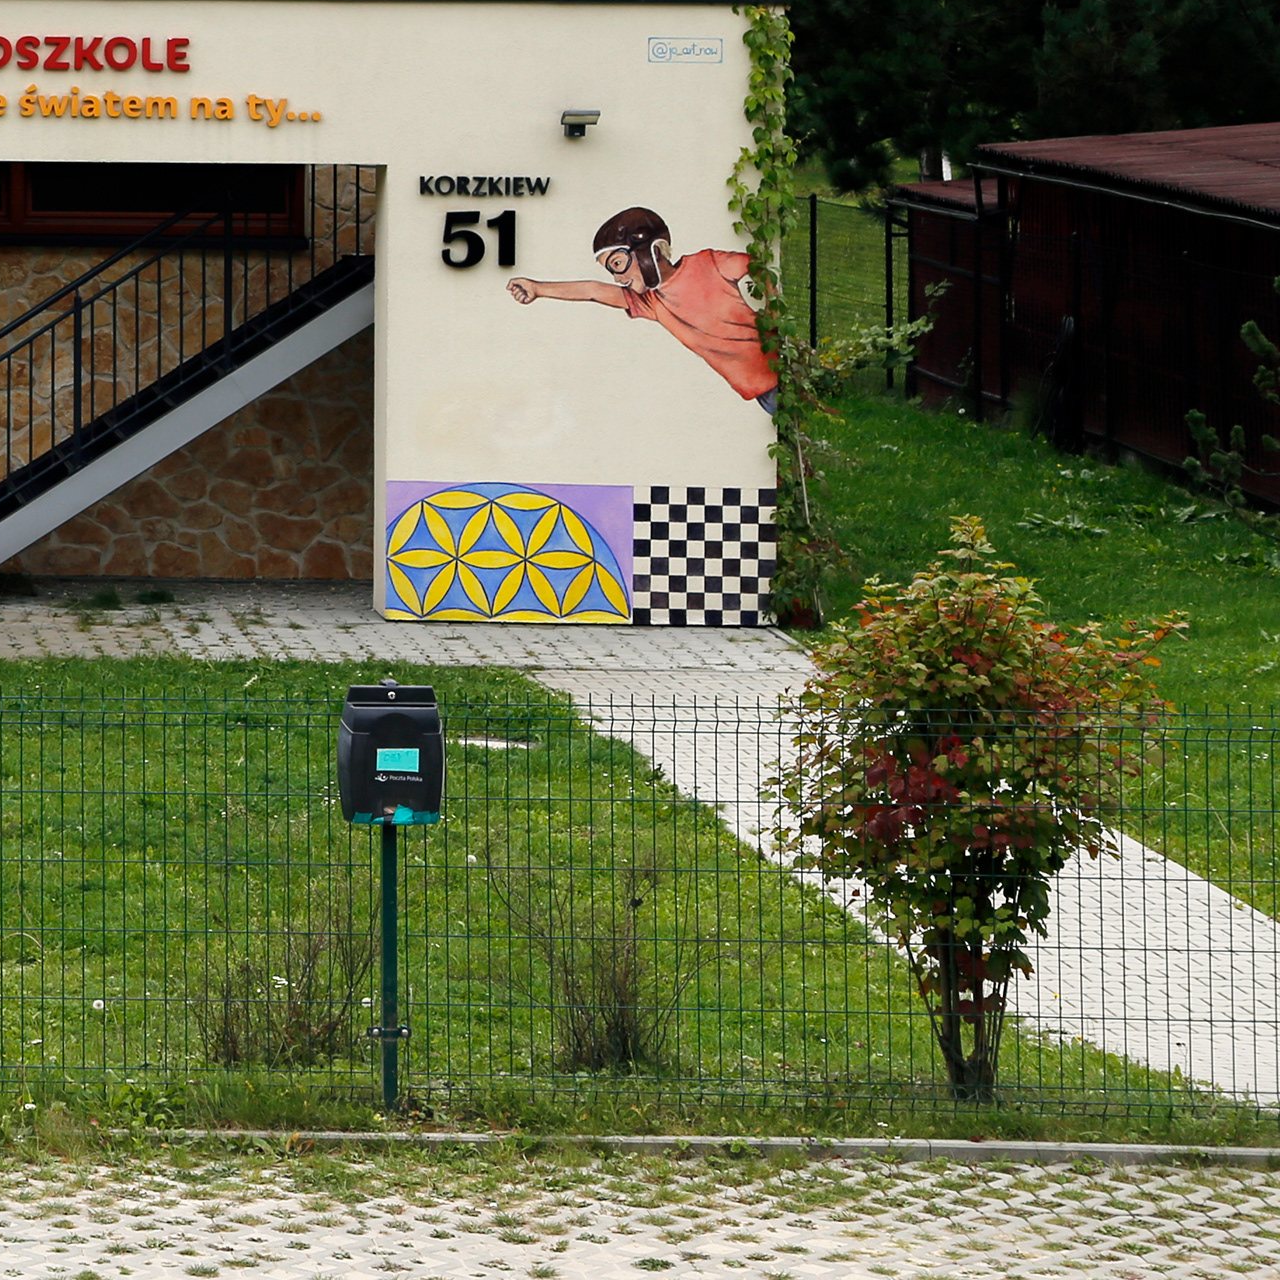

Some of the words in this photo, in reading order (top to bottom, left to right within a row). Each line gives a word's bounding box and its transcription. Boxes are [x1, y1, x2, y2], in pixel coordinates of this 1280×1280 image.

[19, 84, 178, 119] światem
[190, 96, 234, 120] na
[245, 93, 322, 127] ty...
[419, 175, 551, 197] KORZKIEW
[441, 210, 516, 268] 51
